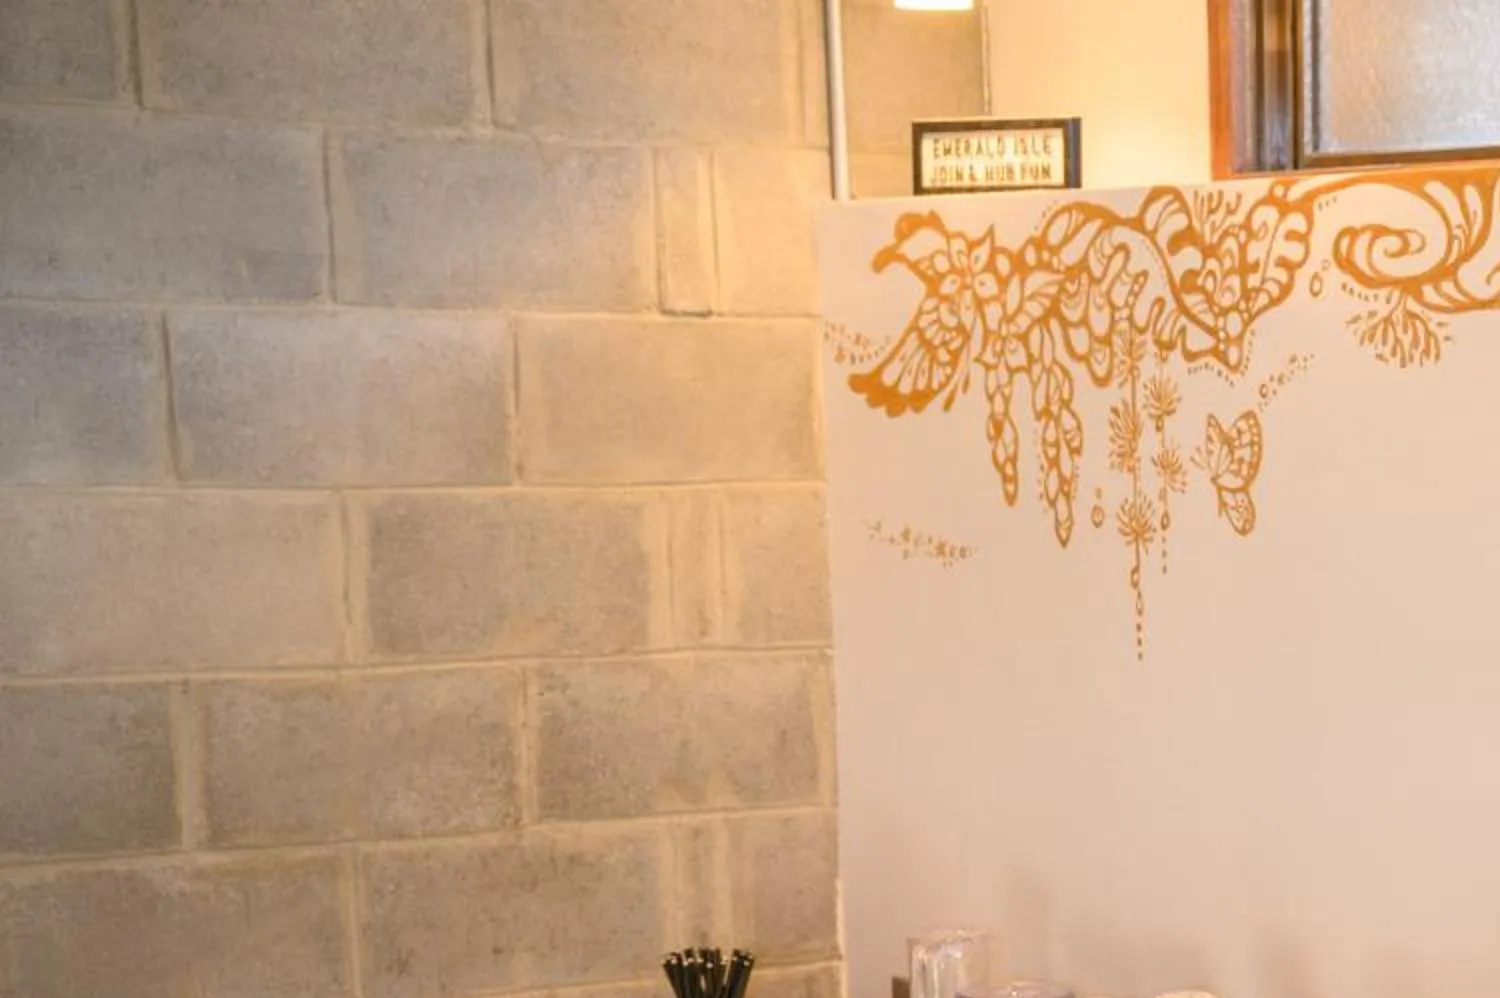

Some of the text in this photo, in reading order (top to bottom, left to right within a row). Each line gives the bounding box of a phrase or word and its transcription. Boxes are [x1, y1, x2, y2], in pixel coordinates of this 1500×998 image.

[932, 135, 1006, 159] EMERALD
[930, 164, 965, 184] JOIN
[1019, 161, 1052, 181] FUN
